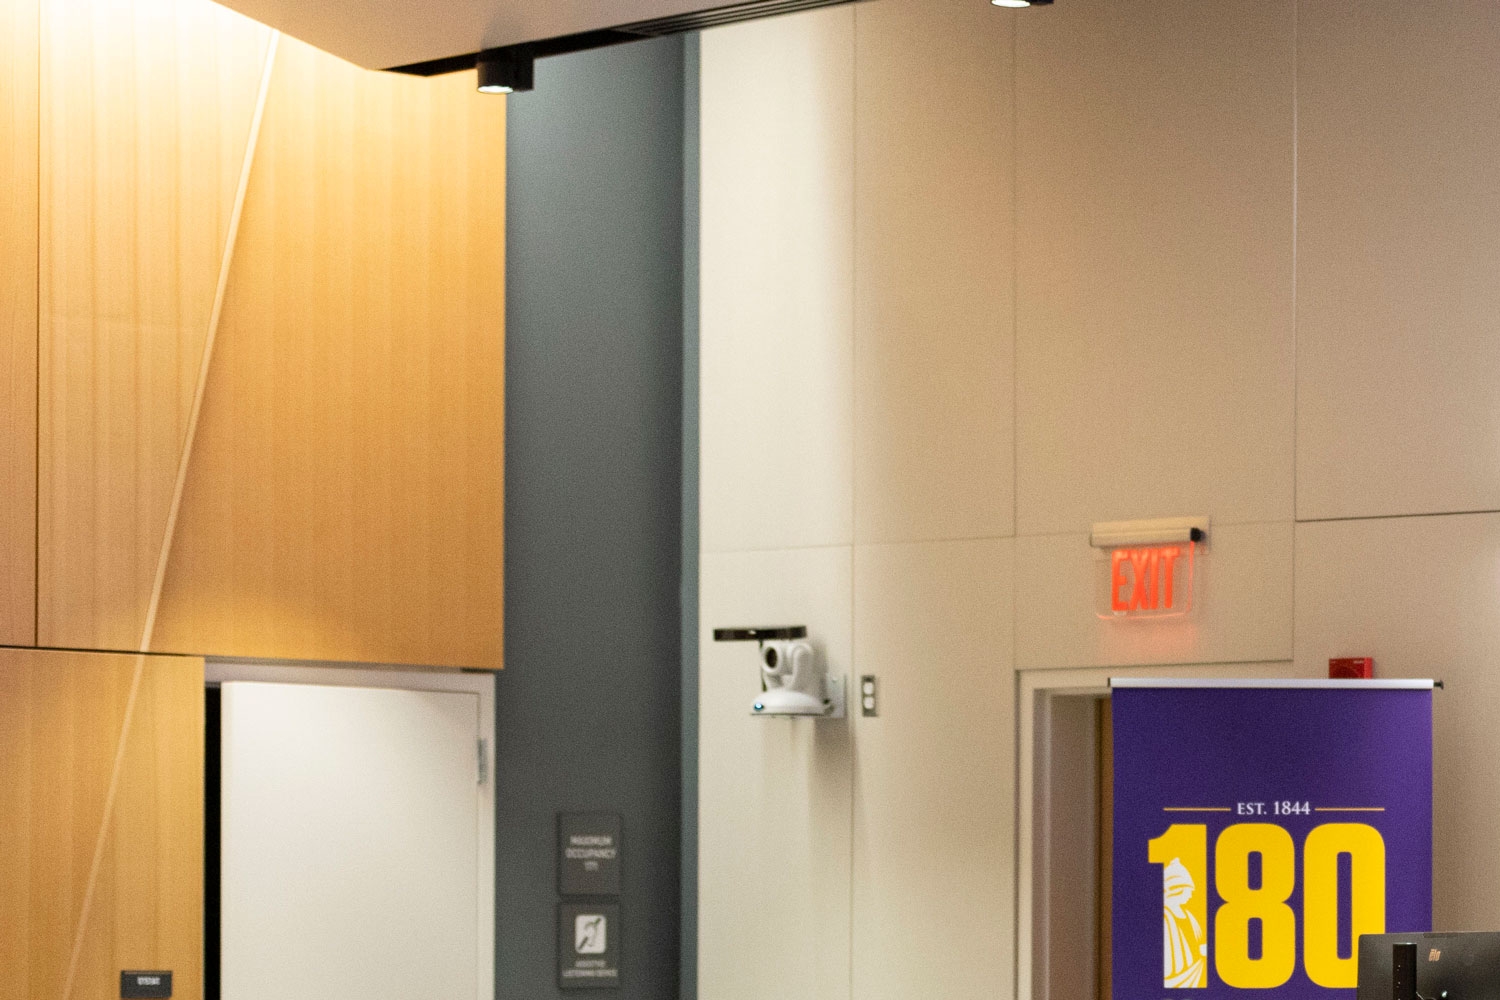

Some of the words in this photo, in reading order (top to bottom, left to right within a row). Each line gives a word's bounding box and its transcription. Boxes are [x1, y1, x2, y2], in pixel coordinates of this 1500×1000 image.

[1111, 547, 1180, 611] EXIT
[1237, 803, 1267, 815] EST.
[1273, 801, 1311, 815] 1844
[1148, 823, 1385, 988] 180
